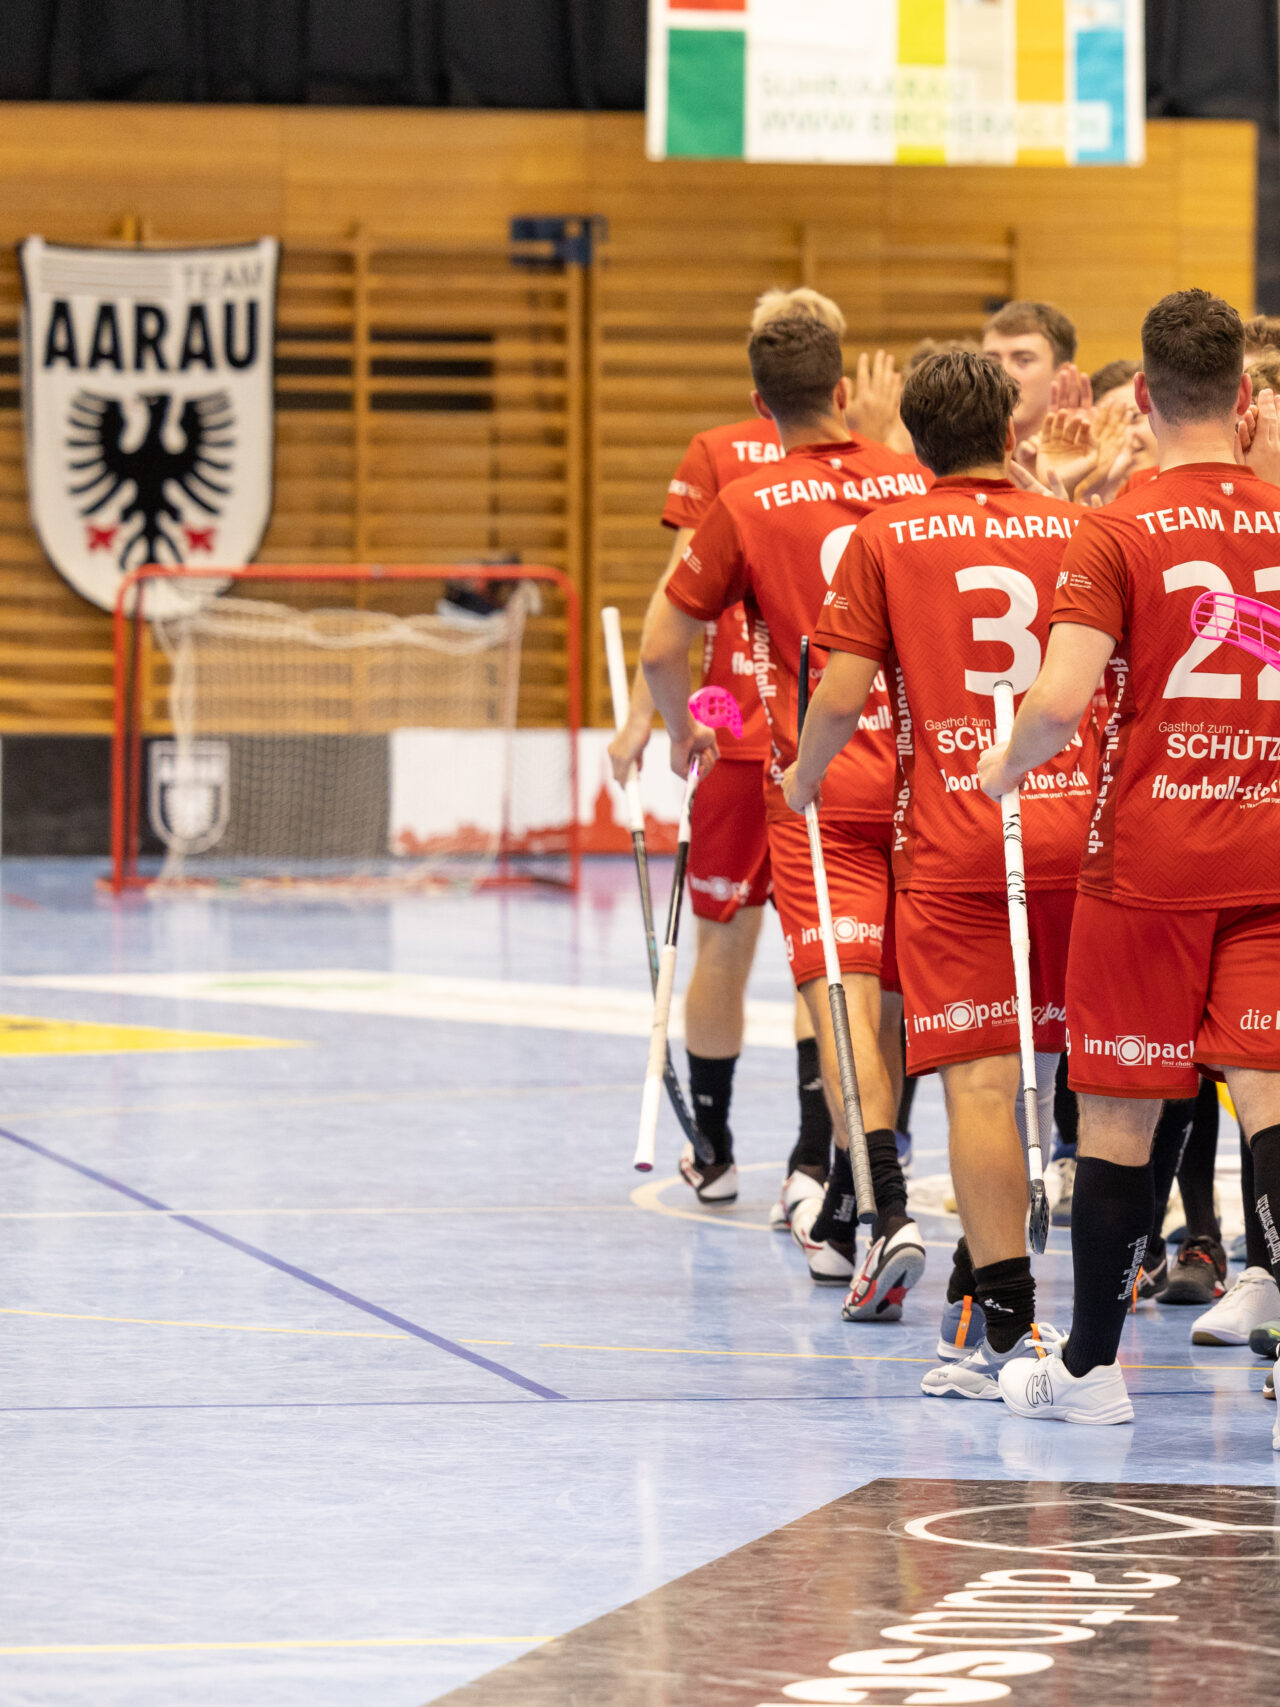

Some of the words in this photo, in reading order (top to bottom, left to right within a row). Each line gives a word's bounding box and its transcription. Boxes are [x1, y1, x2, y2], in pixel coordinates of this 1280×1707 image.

[183, 262, 264, 291] TEAM
[44, 300, 260, 372] AARAU
[754, 479, 837, 510] TEAM
[842, 473, 928, 502] AARAU
[889, 514, 976, 544] TEAM
[1136, 506, 1226, 536] TEAM
[954, 565, 1042, 697] 3
[924, 715, 968, 731] Gasthof
[970, 717, 992, 728] zum
[1158, 721, 1205, 733] Gasthof
[1207, 724, 1233, 734] zum
[1239, 1008, 1273, 1031] die
